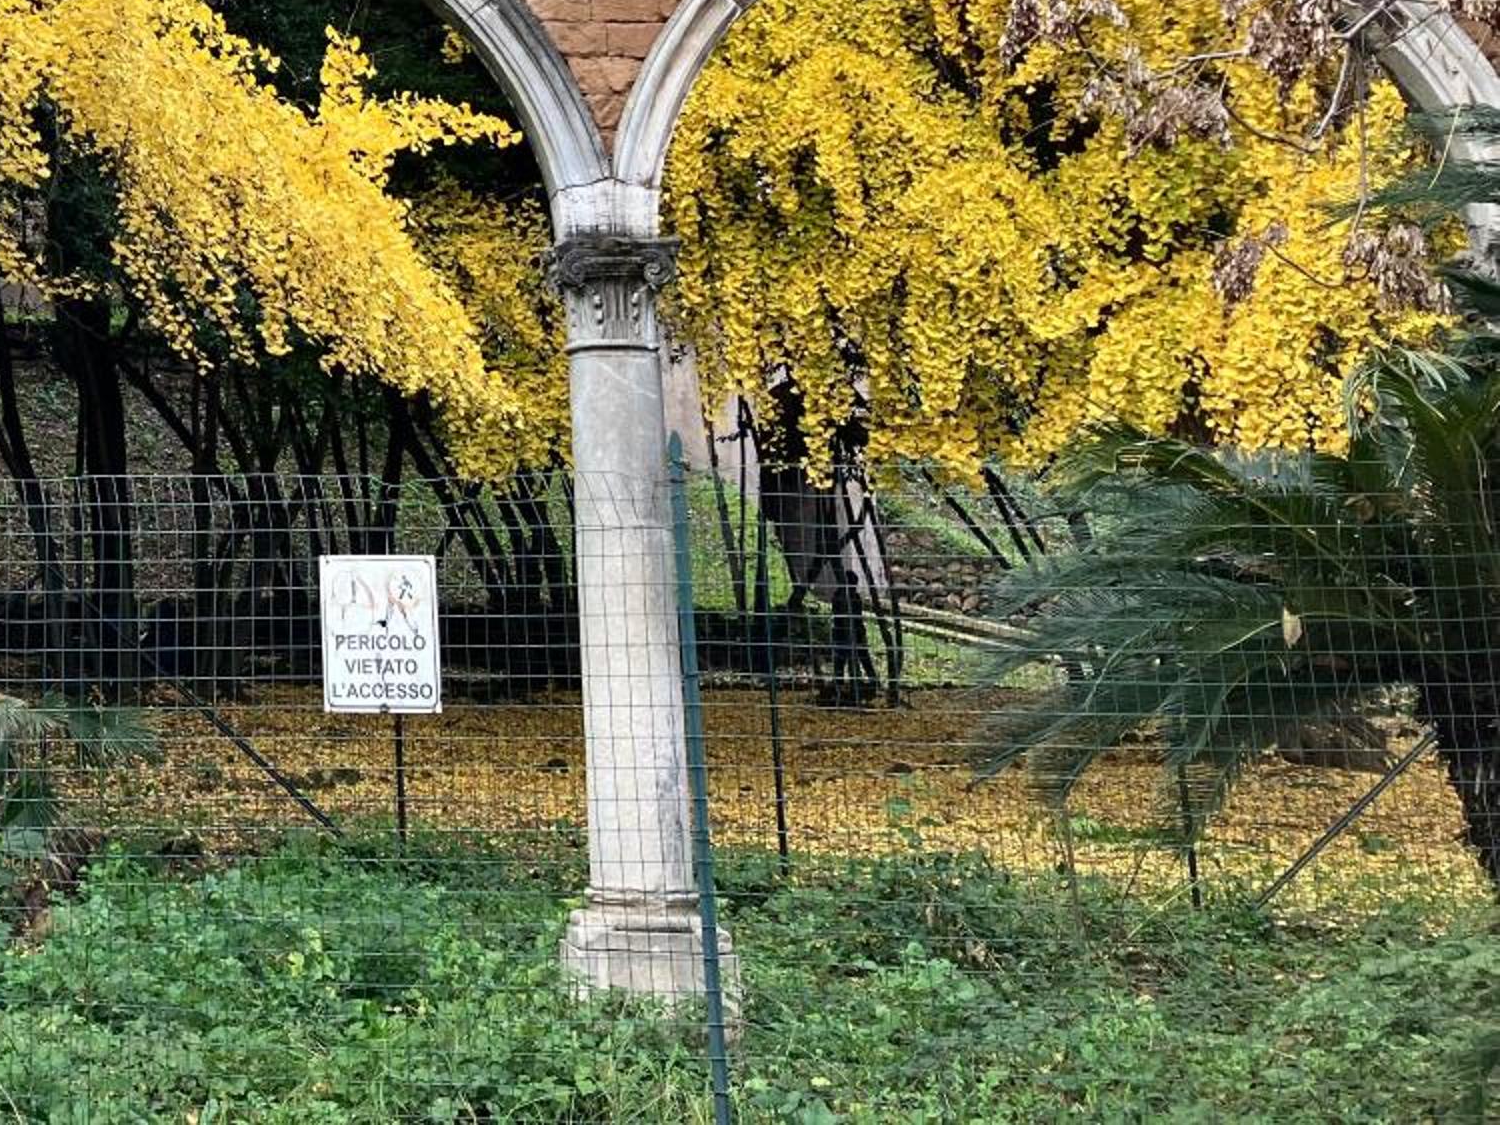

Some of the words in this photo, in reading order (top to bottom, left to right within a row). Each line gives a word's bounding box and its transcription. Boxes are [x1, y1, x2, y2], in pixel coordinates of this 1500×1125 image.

[335, 634, 426, 651] PERICOLO
[344, 658, 418, 674] VIETATO
[332, 683, 434, 700] L'ACCESSO
